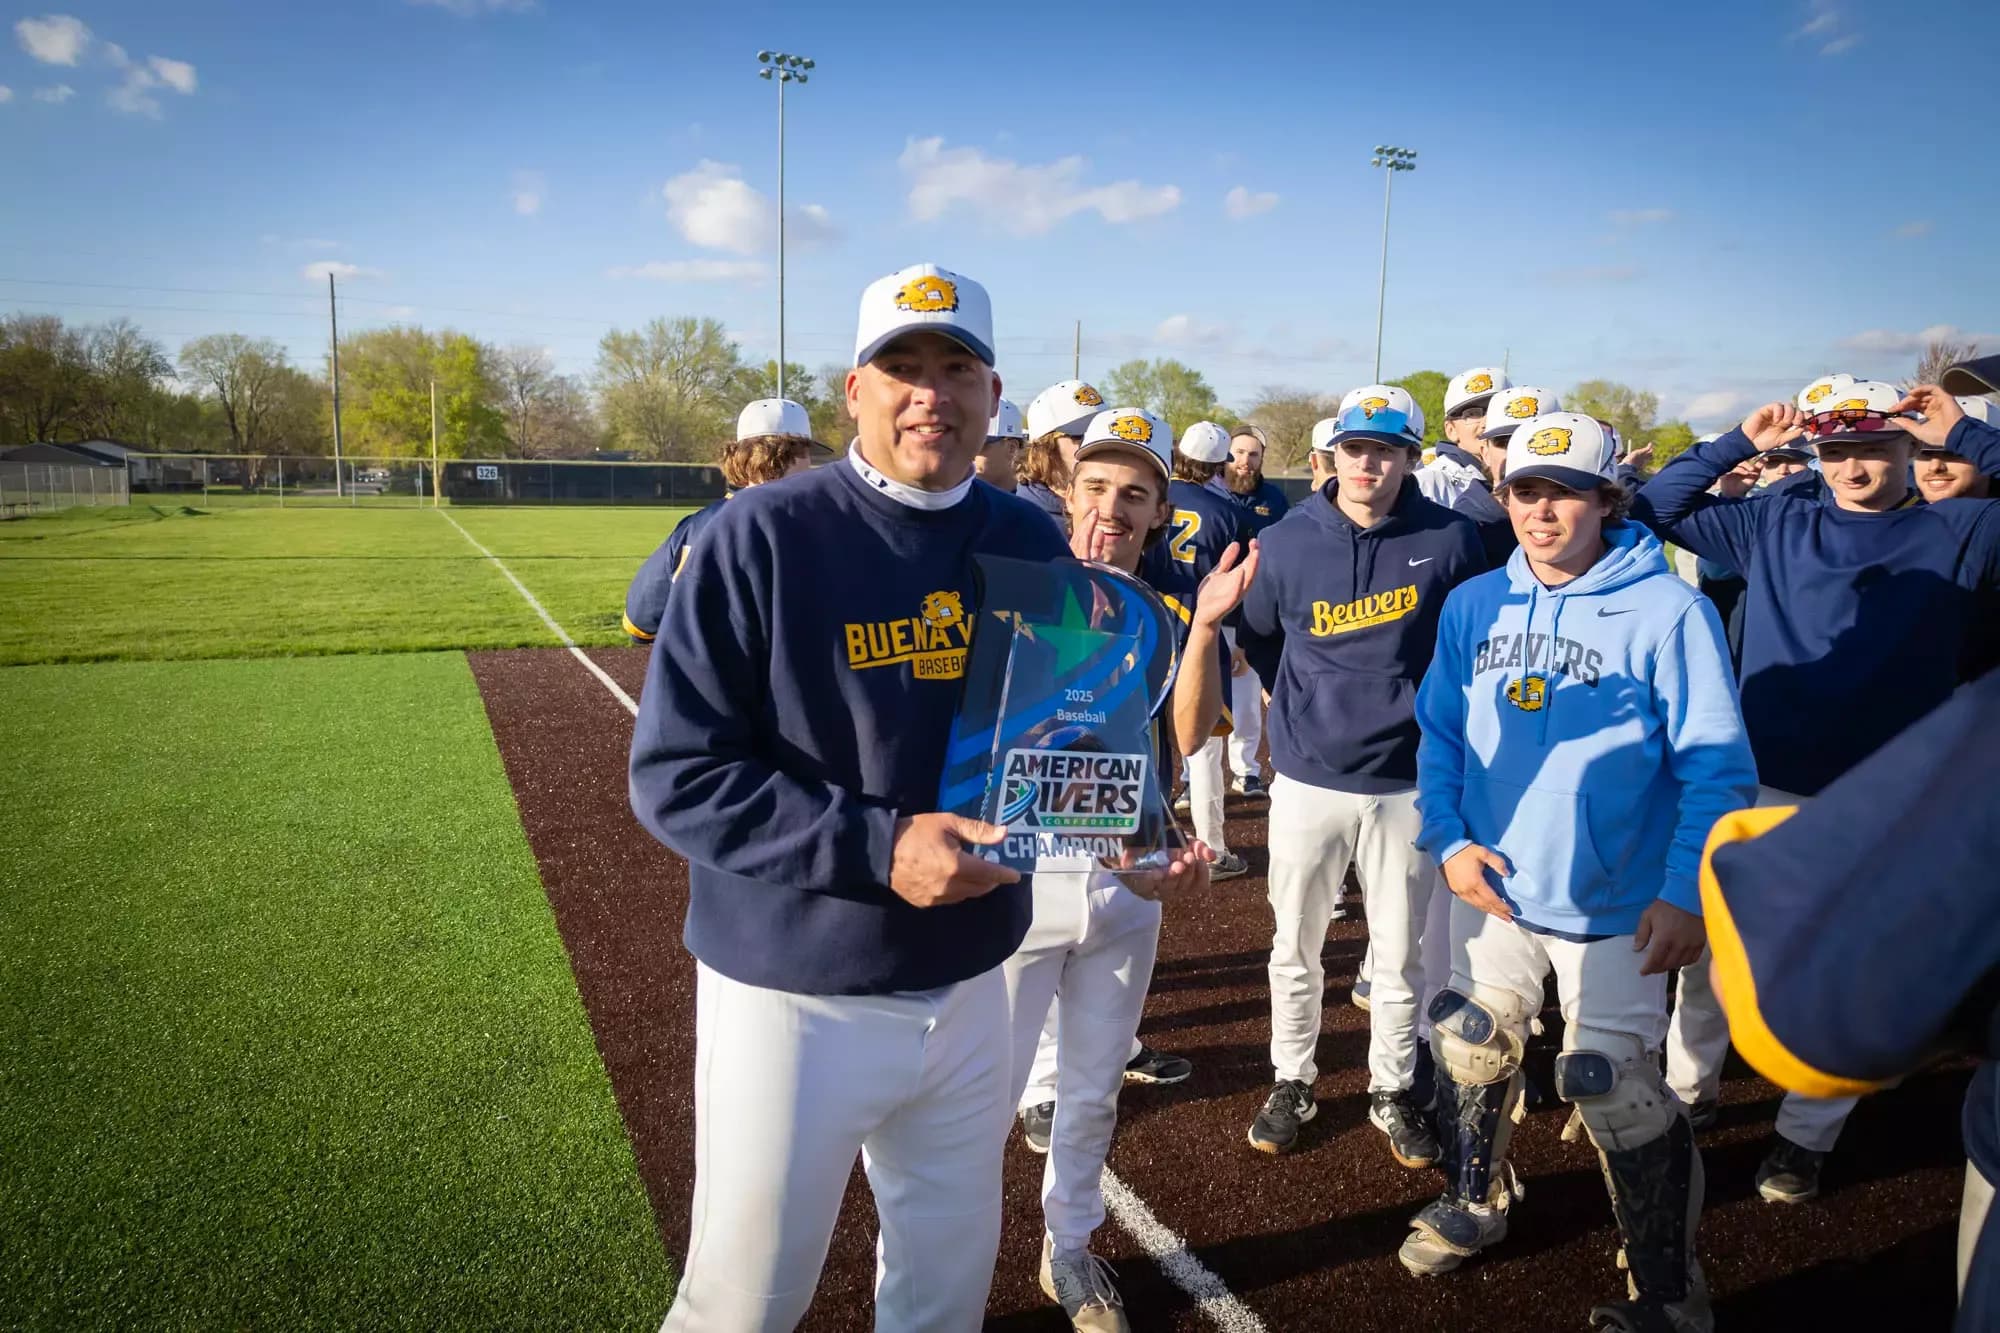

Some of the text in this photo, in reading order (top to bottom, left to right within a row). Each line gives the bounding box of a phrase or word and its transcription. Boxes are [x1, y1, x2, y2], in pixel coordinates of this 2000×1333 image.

[479, 467, 496, 478] 326
[1170, 509, 1202, 564] 2
[1310, 584, 1418, 637] Beavers
[844, 617, 952, 664] BUENA
[1475, 632, 1603, 688] BEAVERS
[1064, 688, 1094, 703] 2025
[1056, 708, 1106, 724] Baseball
[1007, 753, 1142, 781] AMERICAN
[1001, 778, 1139, 827] RIVERS
[1044, 816, 1131, 827] CONFERENCE
[1003, 835, 1124, 859] CHAMPION
